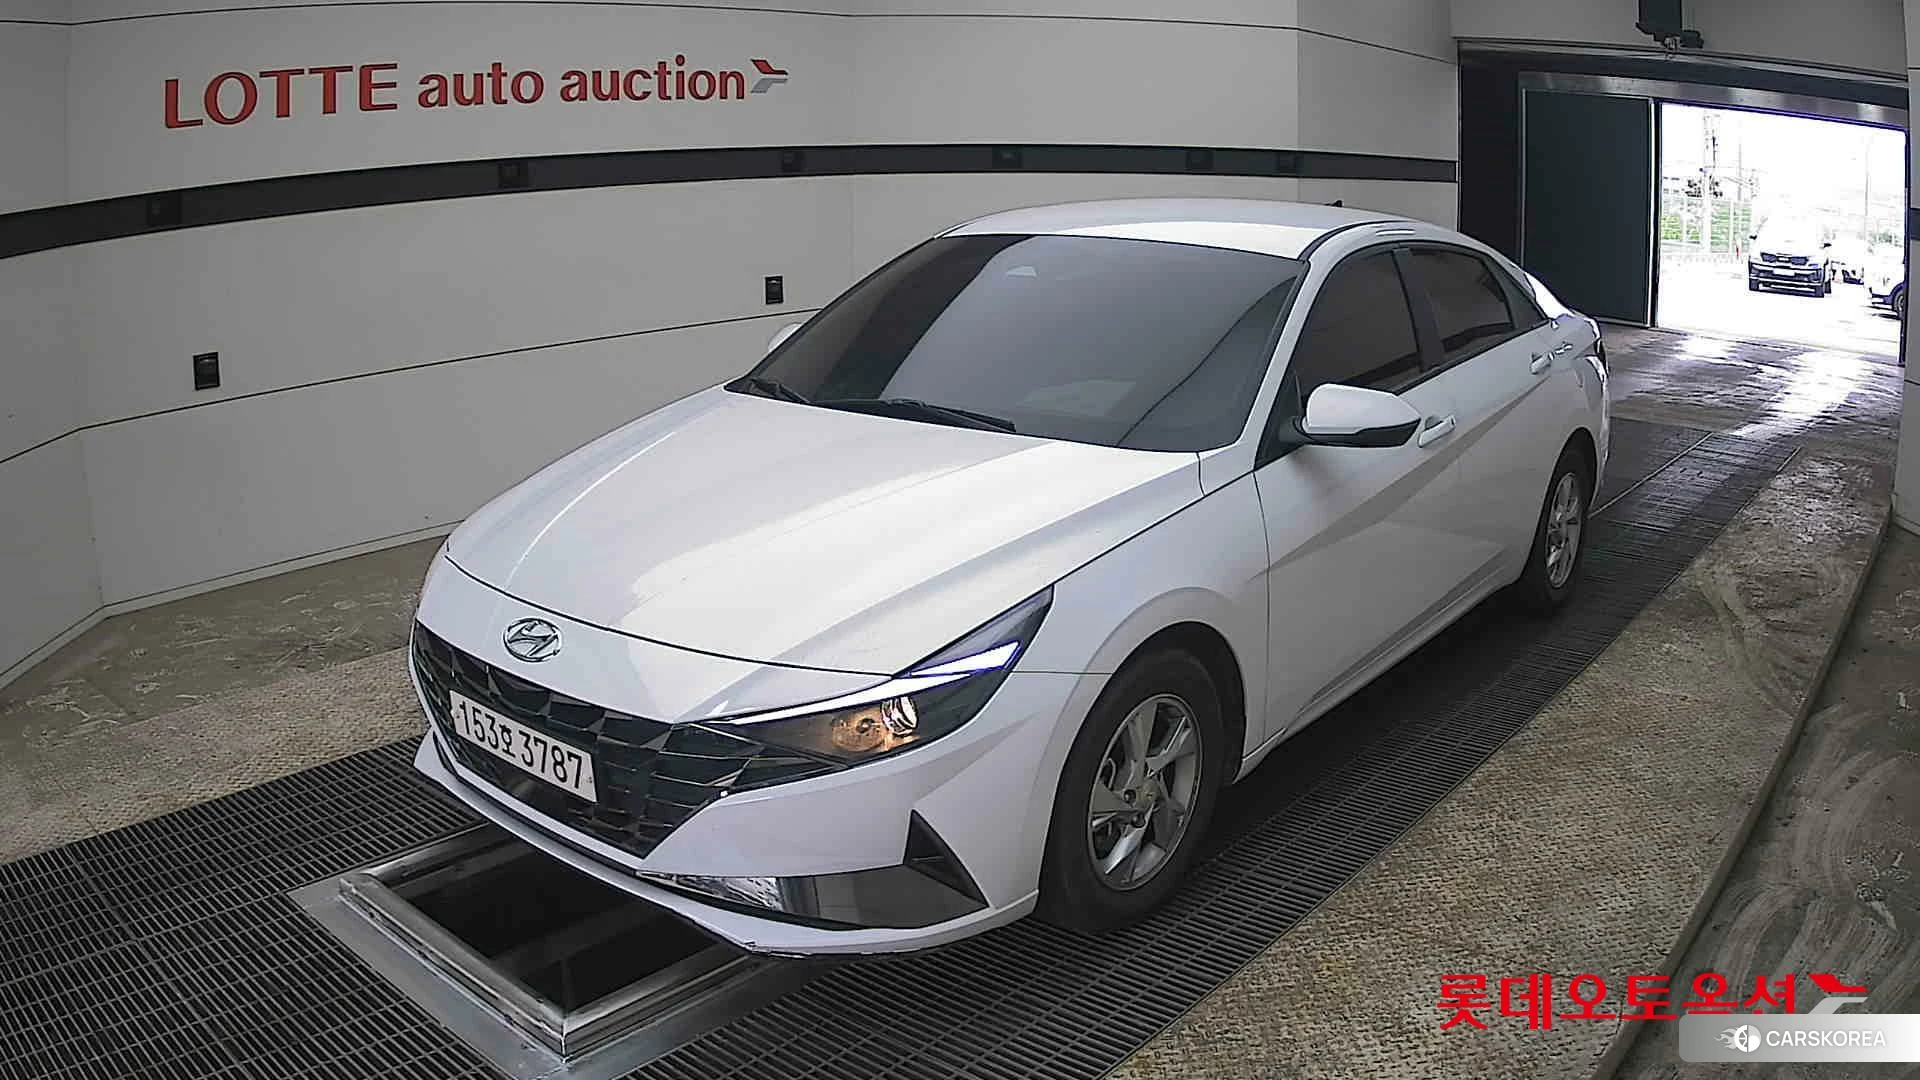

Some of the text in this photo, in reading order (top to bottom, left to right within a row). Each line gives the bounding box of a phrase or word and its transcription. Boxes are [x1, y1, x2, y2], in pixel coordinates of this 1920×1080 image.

[163, 55, 747, 129] LOTTE auto auction
[519, 729, 582, 789] 3787
